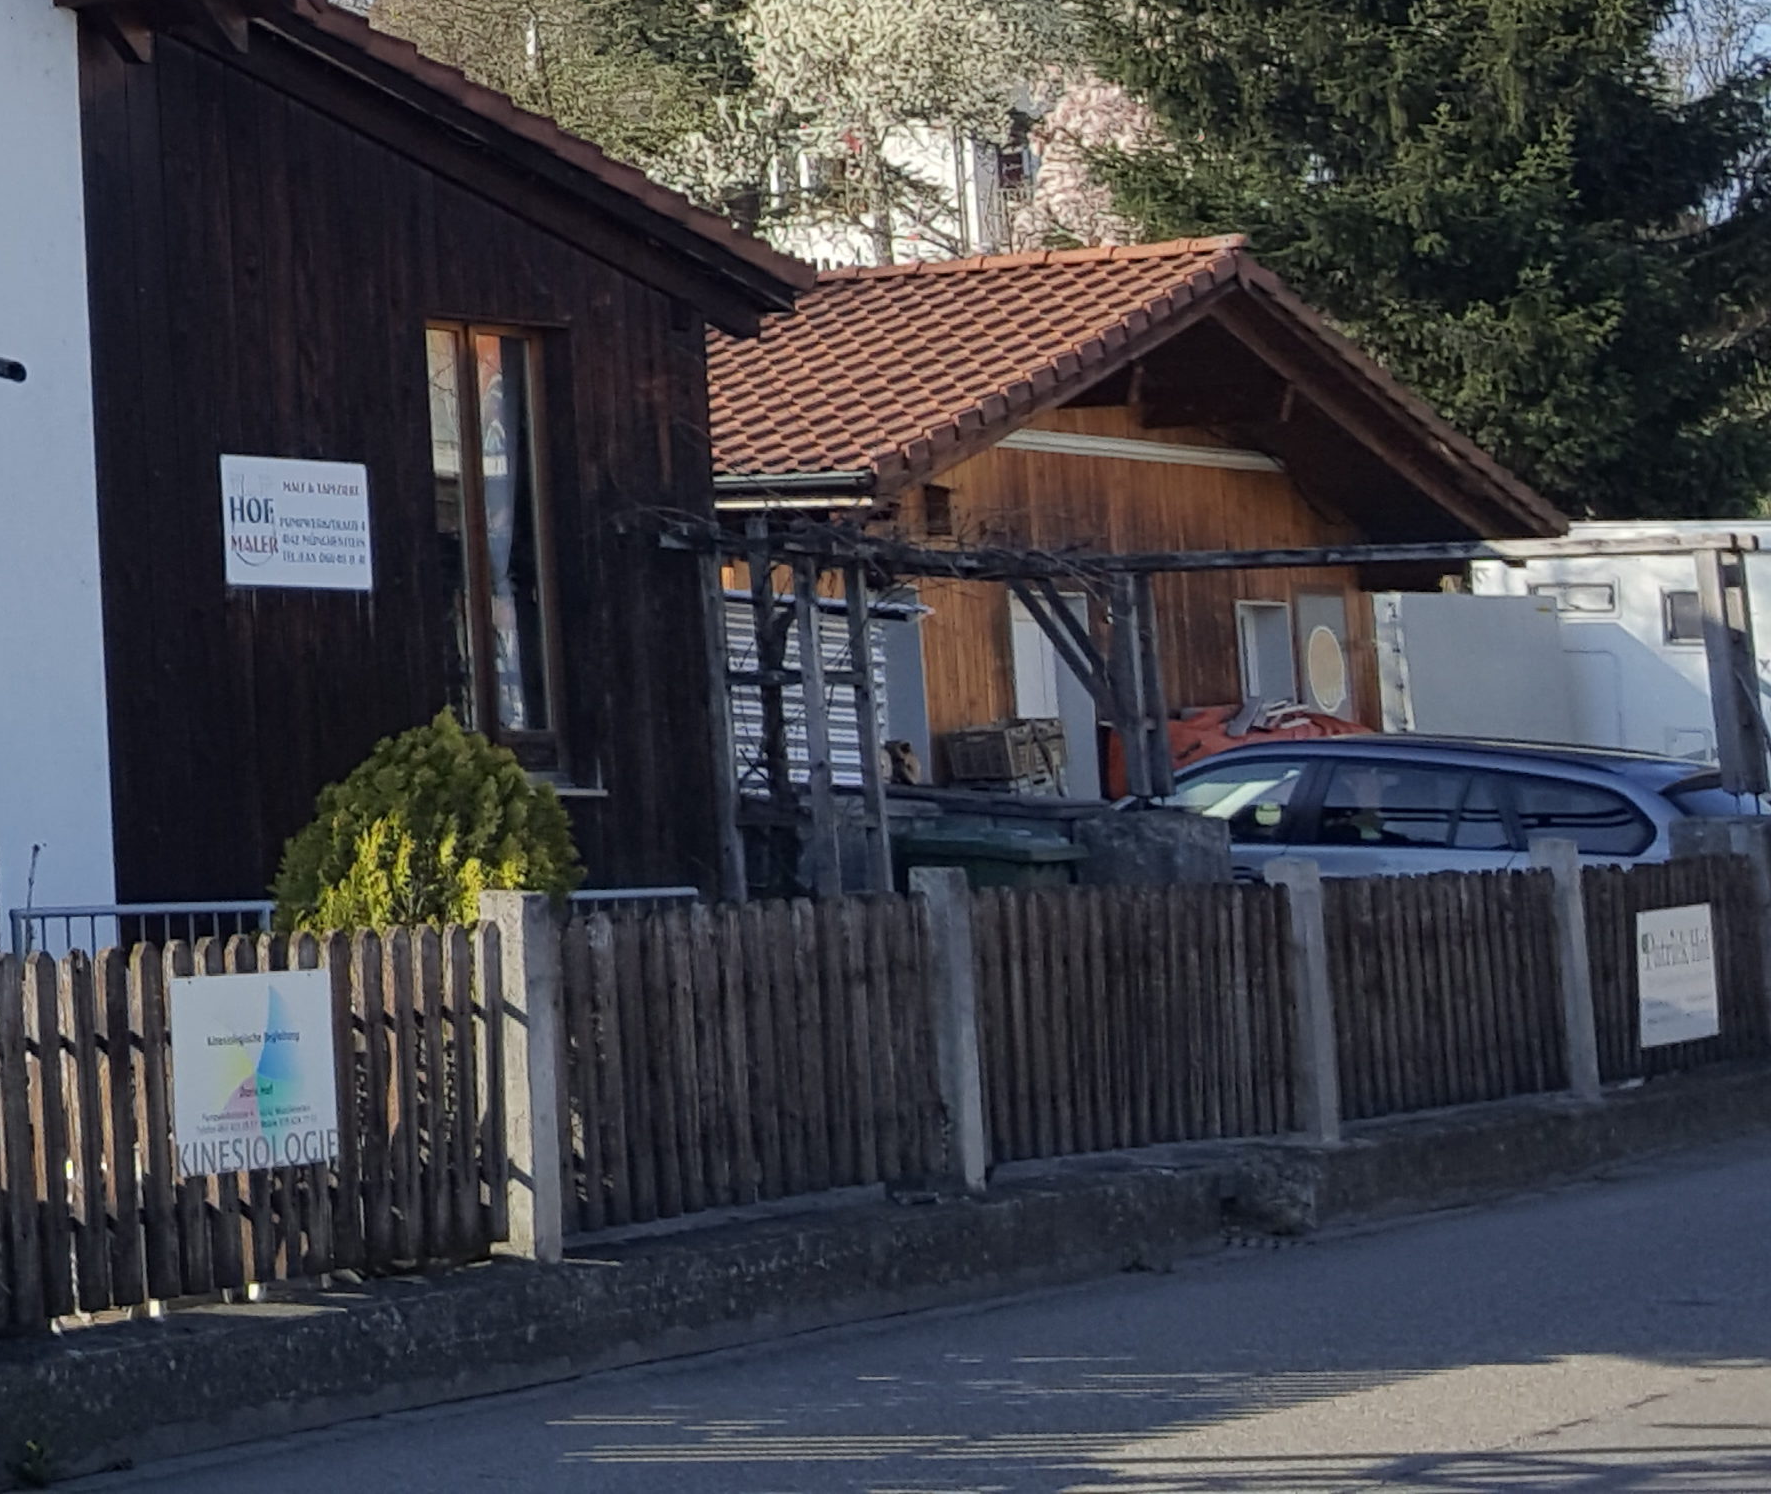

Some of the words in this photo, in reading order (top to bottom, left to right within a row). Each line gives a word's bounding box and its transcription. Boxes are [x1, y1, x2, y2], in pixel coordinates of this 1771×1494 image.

[229, 496, 274, 524] HOF
[231, 535, 279, 554] MALER
[177, 1128, 340, 1177] KINESIOLOGIE
